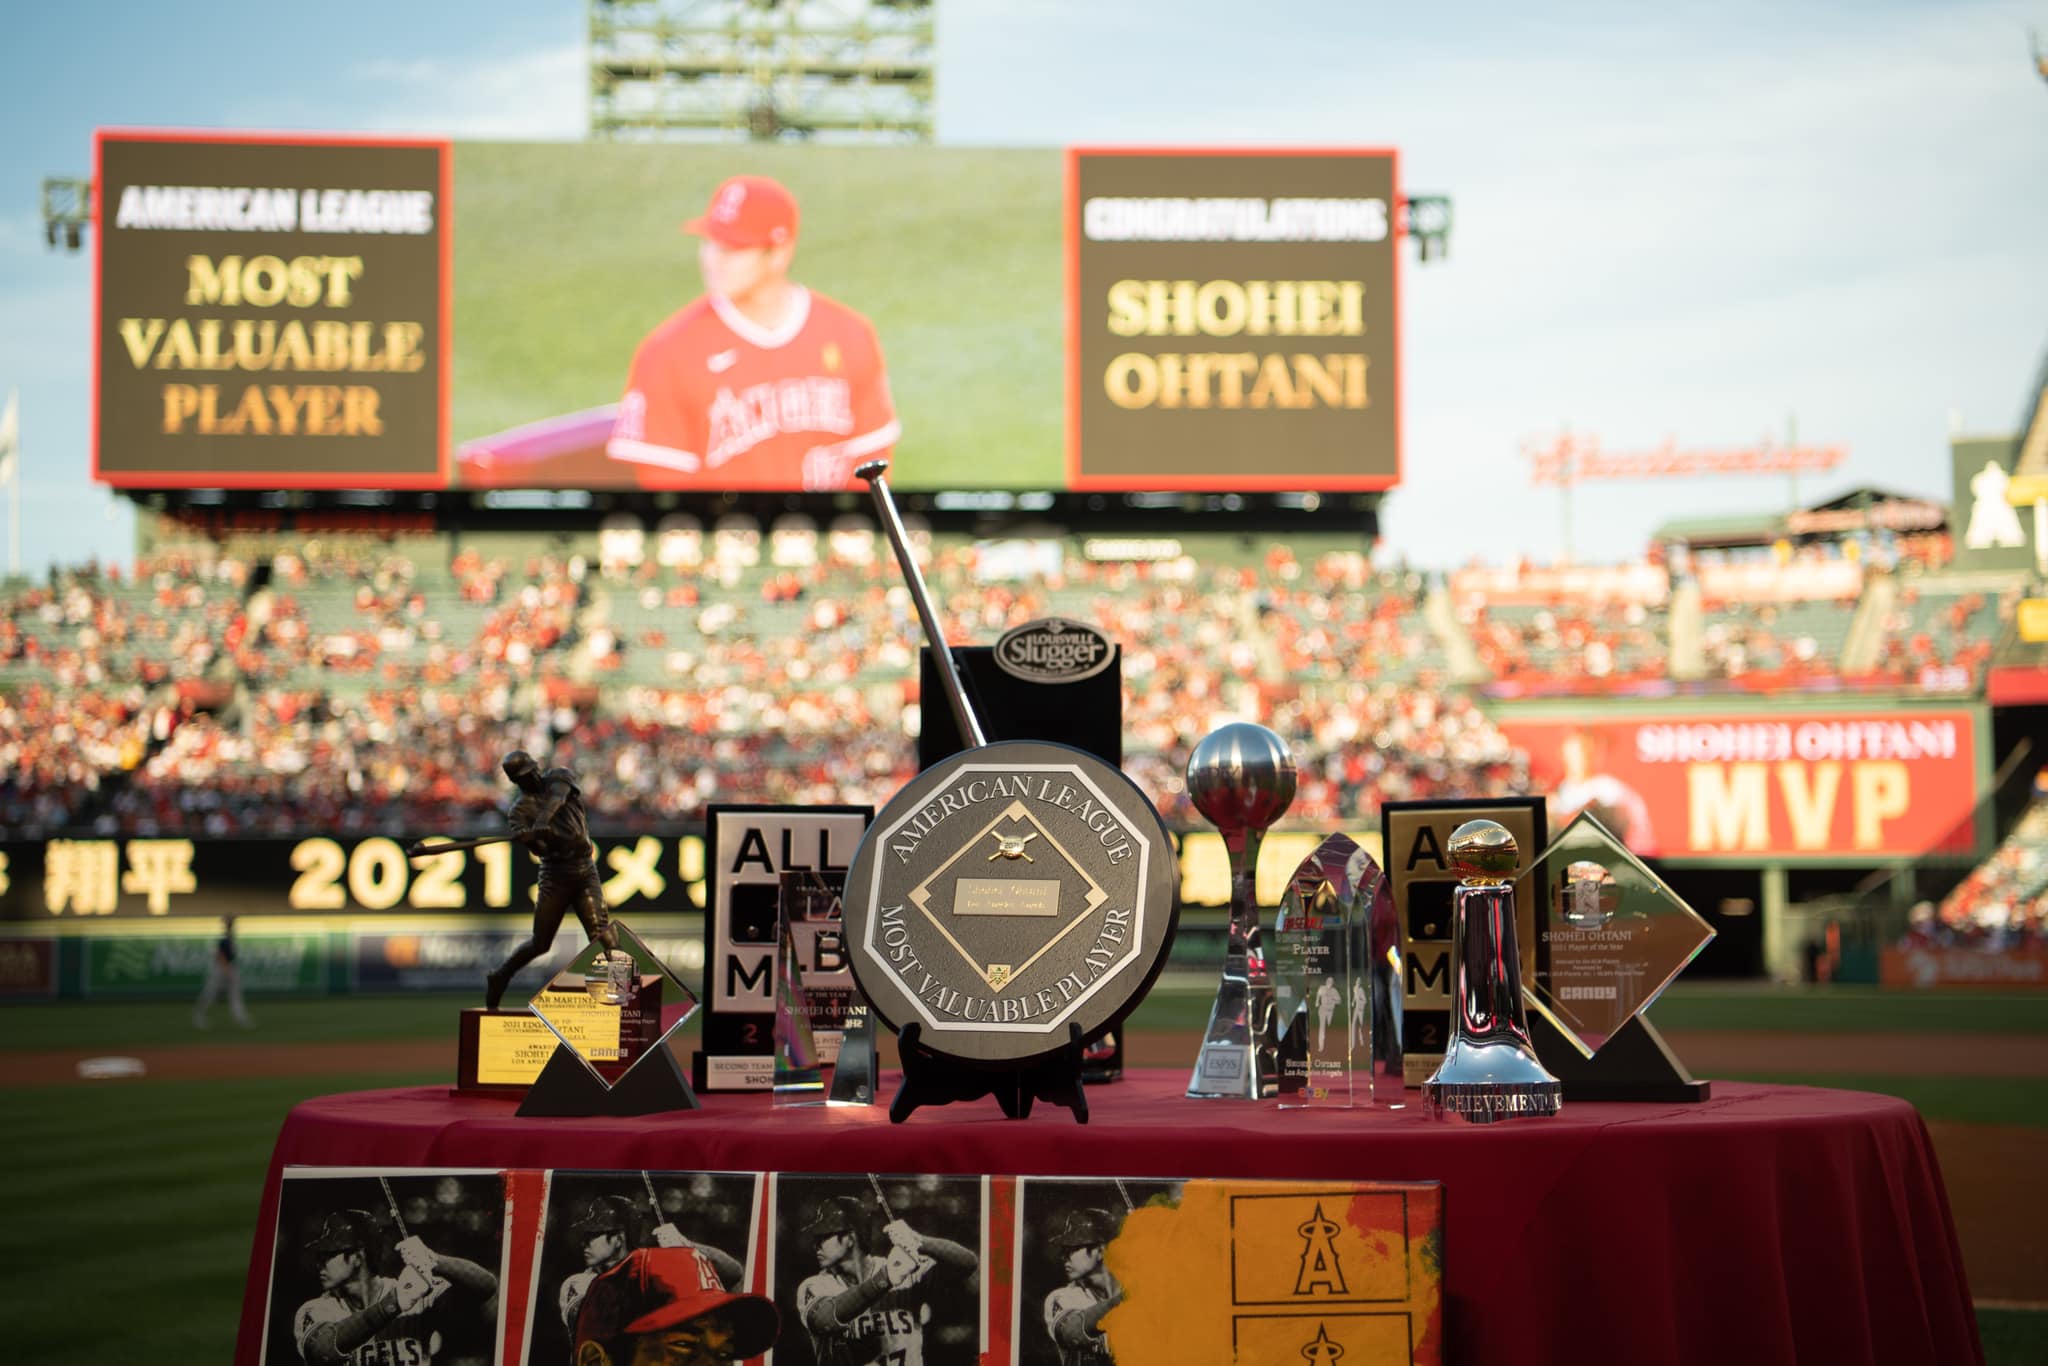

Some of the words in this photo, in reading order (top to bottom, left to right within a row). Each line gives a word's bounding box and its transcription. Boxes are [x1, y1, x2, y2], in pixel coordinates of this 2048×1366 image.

[116, 186, 295, 231] AMERICAN
[301, 190, 433, 233] LEAGUE
[186, 255, 363, 307] MOST
[1108, 280, 1365, 336] SHOHEI
[119, 319, 424, 372] VALUABLE
[1104, 353, 1369, 408] OHTANI
[162, 384, 382, 435] PLAYER
[1010, 636, 1104, 669] Slugger
[1032, 634, 1095, 646] LOUISVILLE
[1638, 721, 1791, 762] SHOHEI
[1795, 720, 1956, 760] OHTANI
[892, 775, 1032, 864] AMERICAN
[1038, 779, 1132, 865] LEAGUE
[1689, 761, 1909, 850] MVP
[289, 837, 512, 910] 2021
[1542, 931, 1584, 942] SHOHEI
[1588, 930, 1632, 941] OHTANI
[881, 905, 922, 976] MOST
[918, 973, 1058, 1023] VALUABLE
[1055, 908, 1131, 1001] PLAYER
